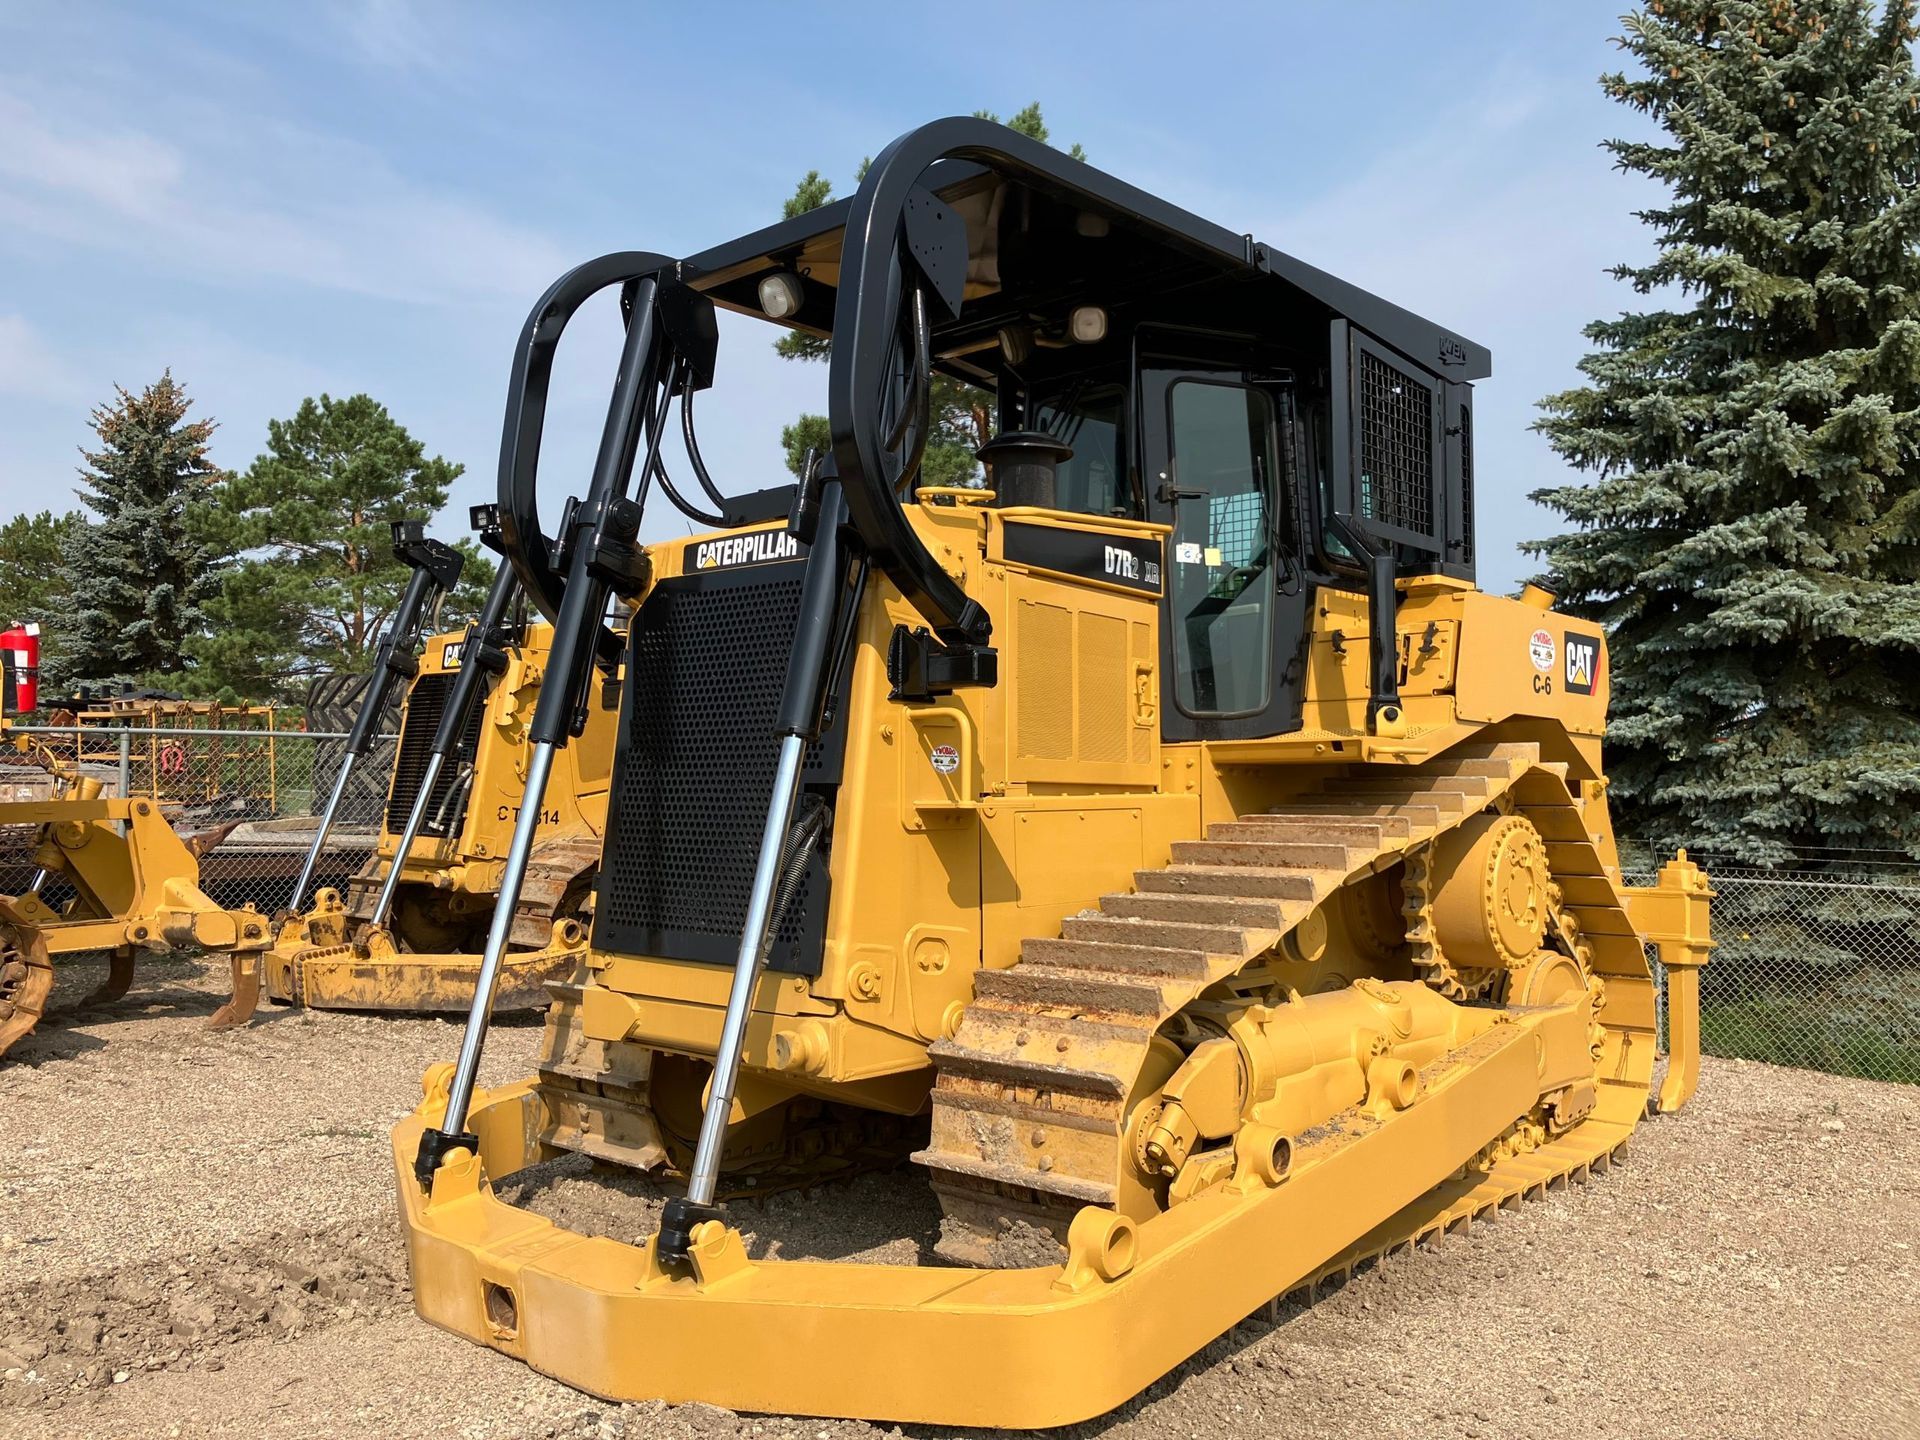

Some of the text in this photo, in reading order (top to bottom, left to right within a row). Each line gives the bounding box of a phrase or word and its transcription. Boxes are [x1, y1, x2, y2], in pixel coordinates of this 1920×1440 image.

[696, 531, 798, 569] CATERPILLAR
[1566, 641, 1593, 686] CAT
[1533, 674, 1552, 696] C-6
